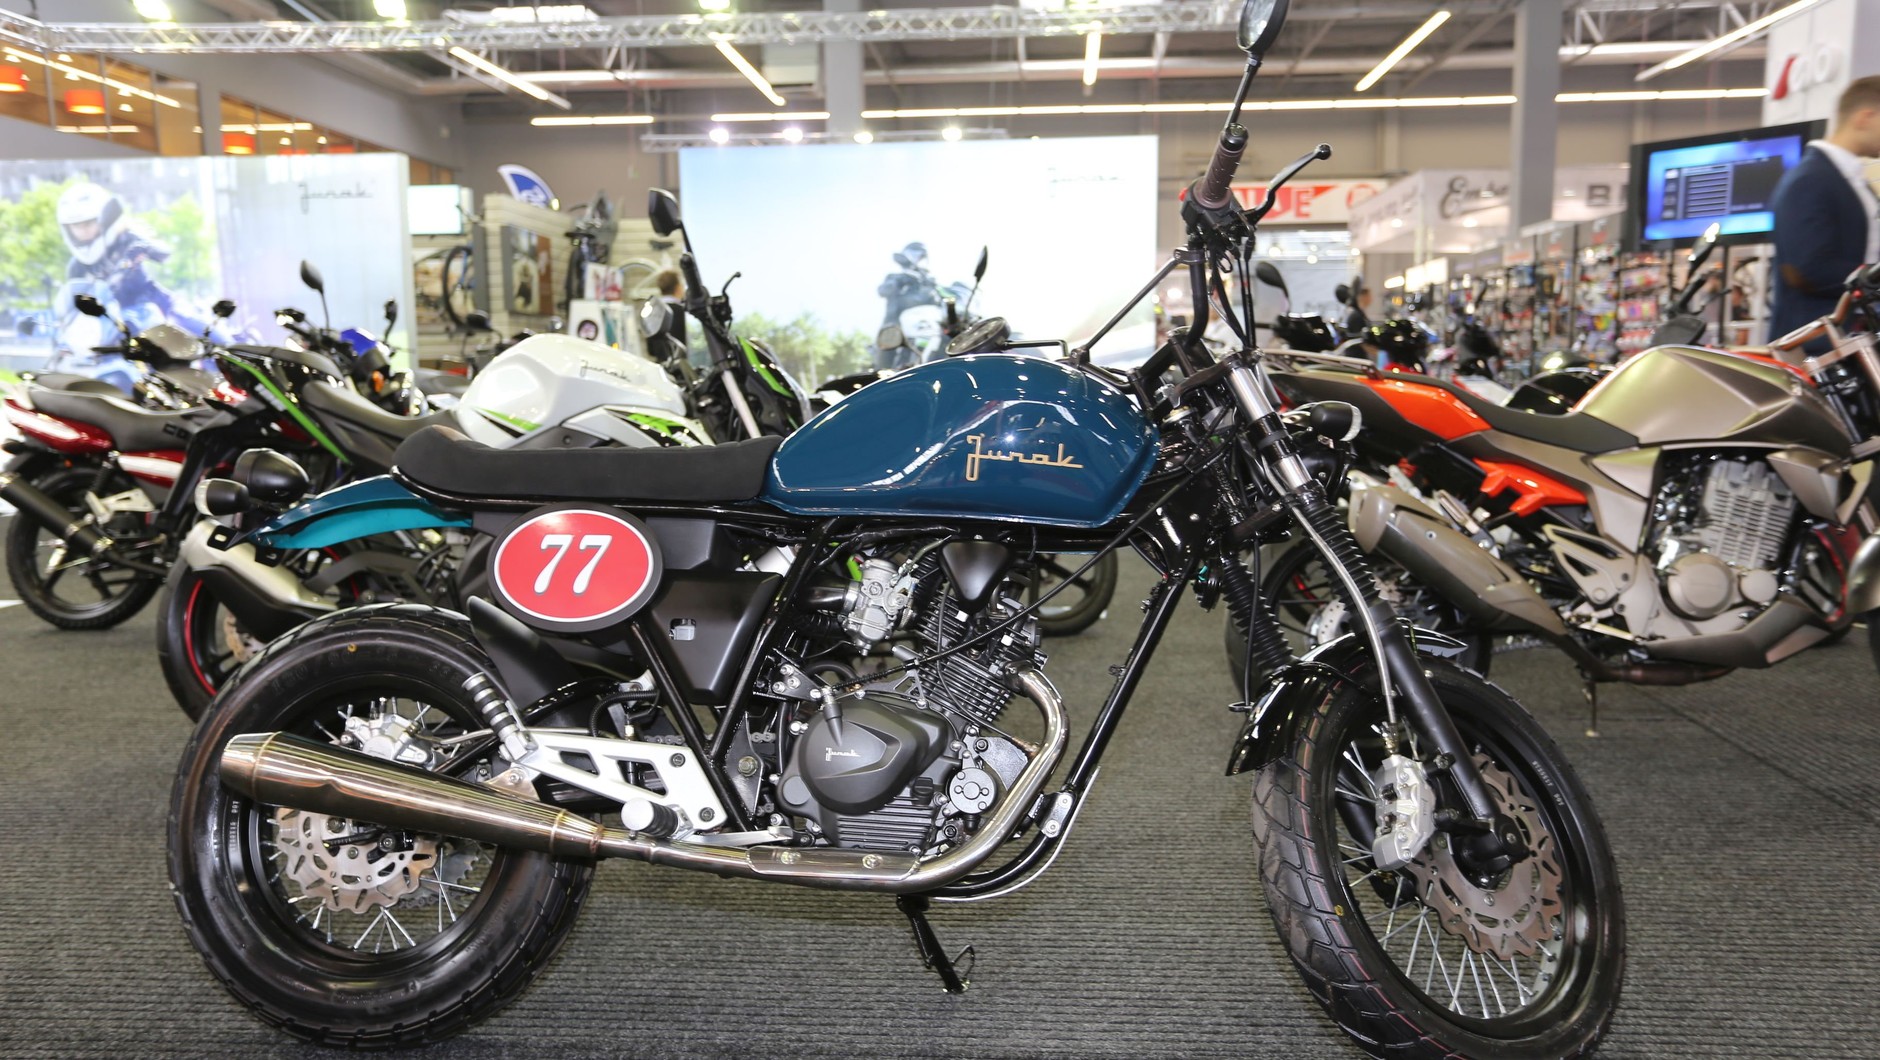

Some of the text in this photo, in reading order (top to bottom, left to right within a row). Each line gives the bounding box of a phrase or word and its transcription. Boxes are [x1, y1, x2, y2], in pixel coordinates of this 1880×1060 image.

[298, 181, 373, 214] Junak
[580, 359, 632, 382] Junak
[966, 434, 1084, 481] Junak
[534, 534, 612, 595] 77
[825, 747, 861, 761] Junak
[231, 800, 240, 813] DOT
